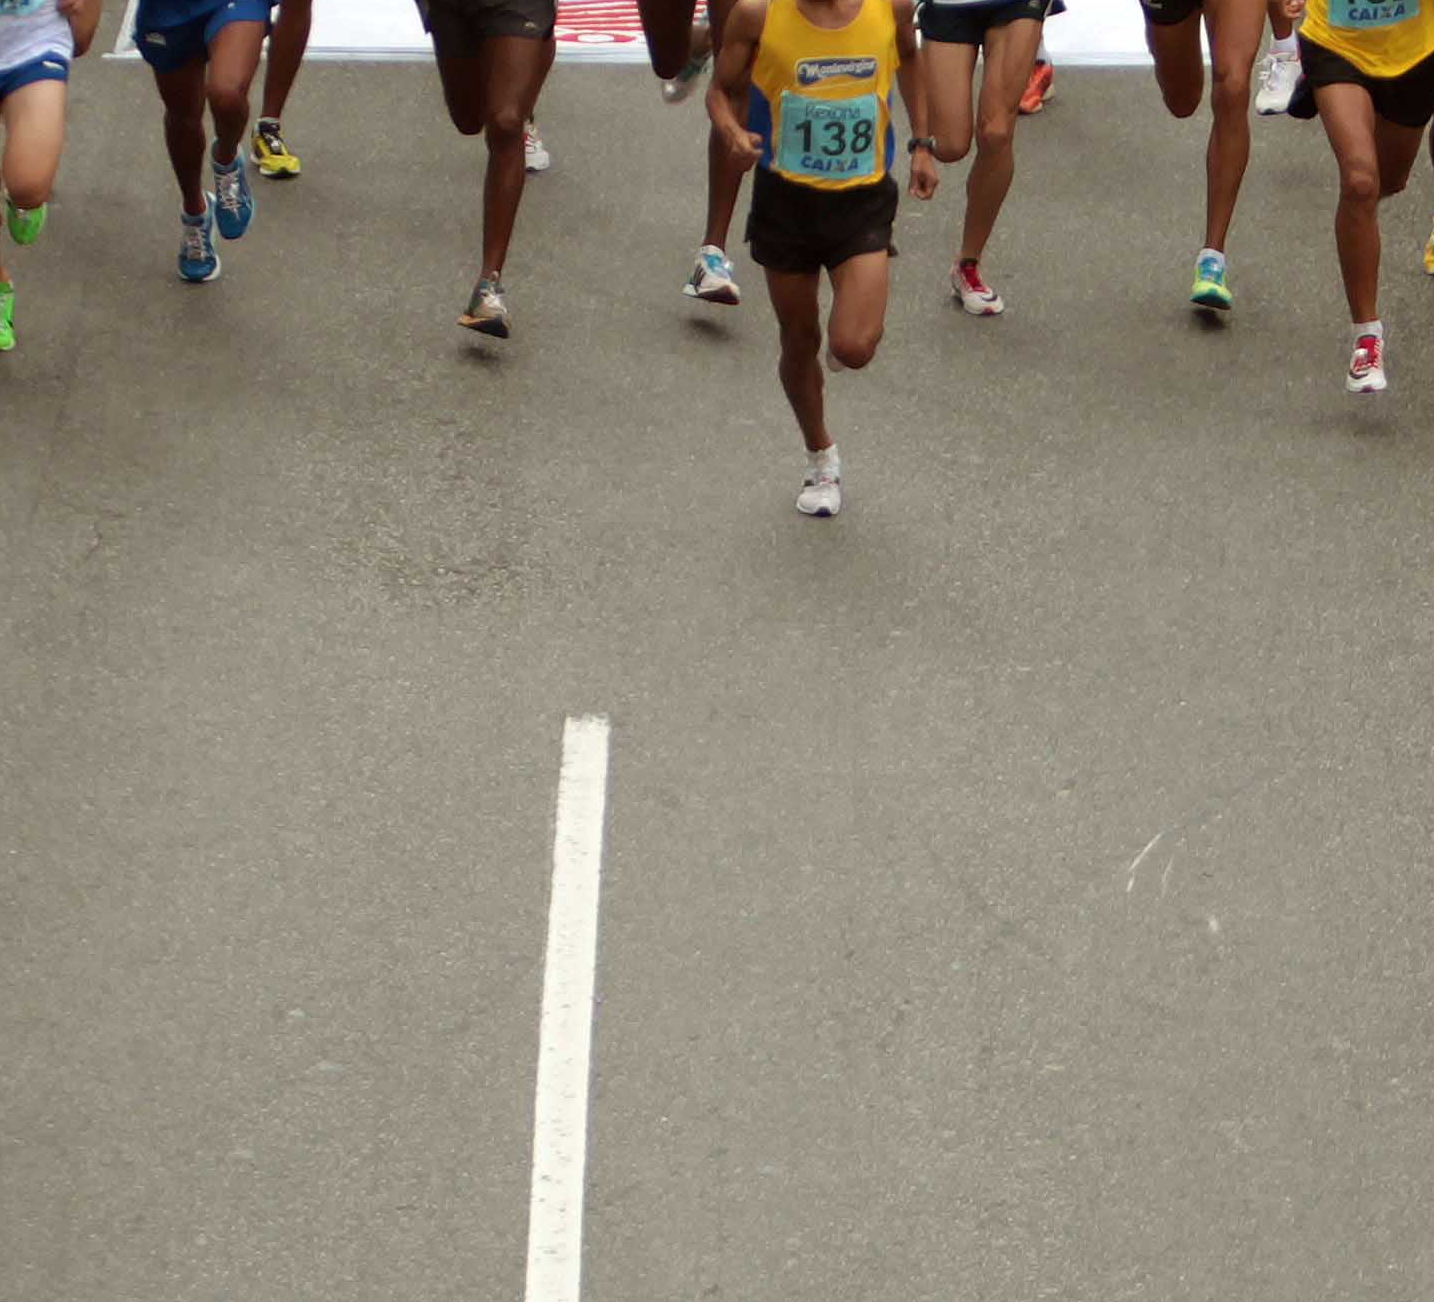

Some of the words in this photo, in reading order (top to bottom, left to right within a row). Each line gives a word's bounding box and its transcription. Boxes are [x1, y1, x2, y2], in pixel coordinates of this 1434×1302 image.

[1348, 6, 1406, 21] CAIXA
[795, 118, 874, 155] 138
[801, 156, 859, 171] CAIXA
